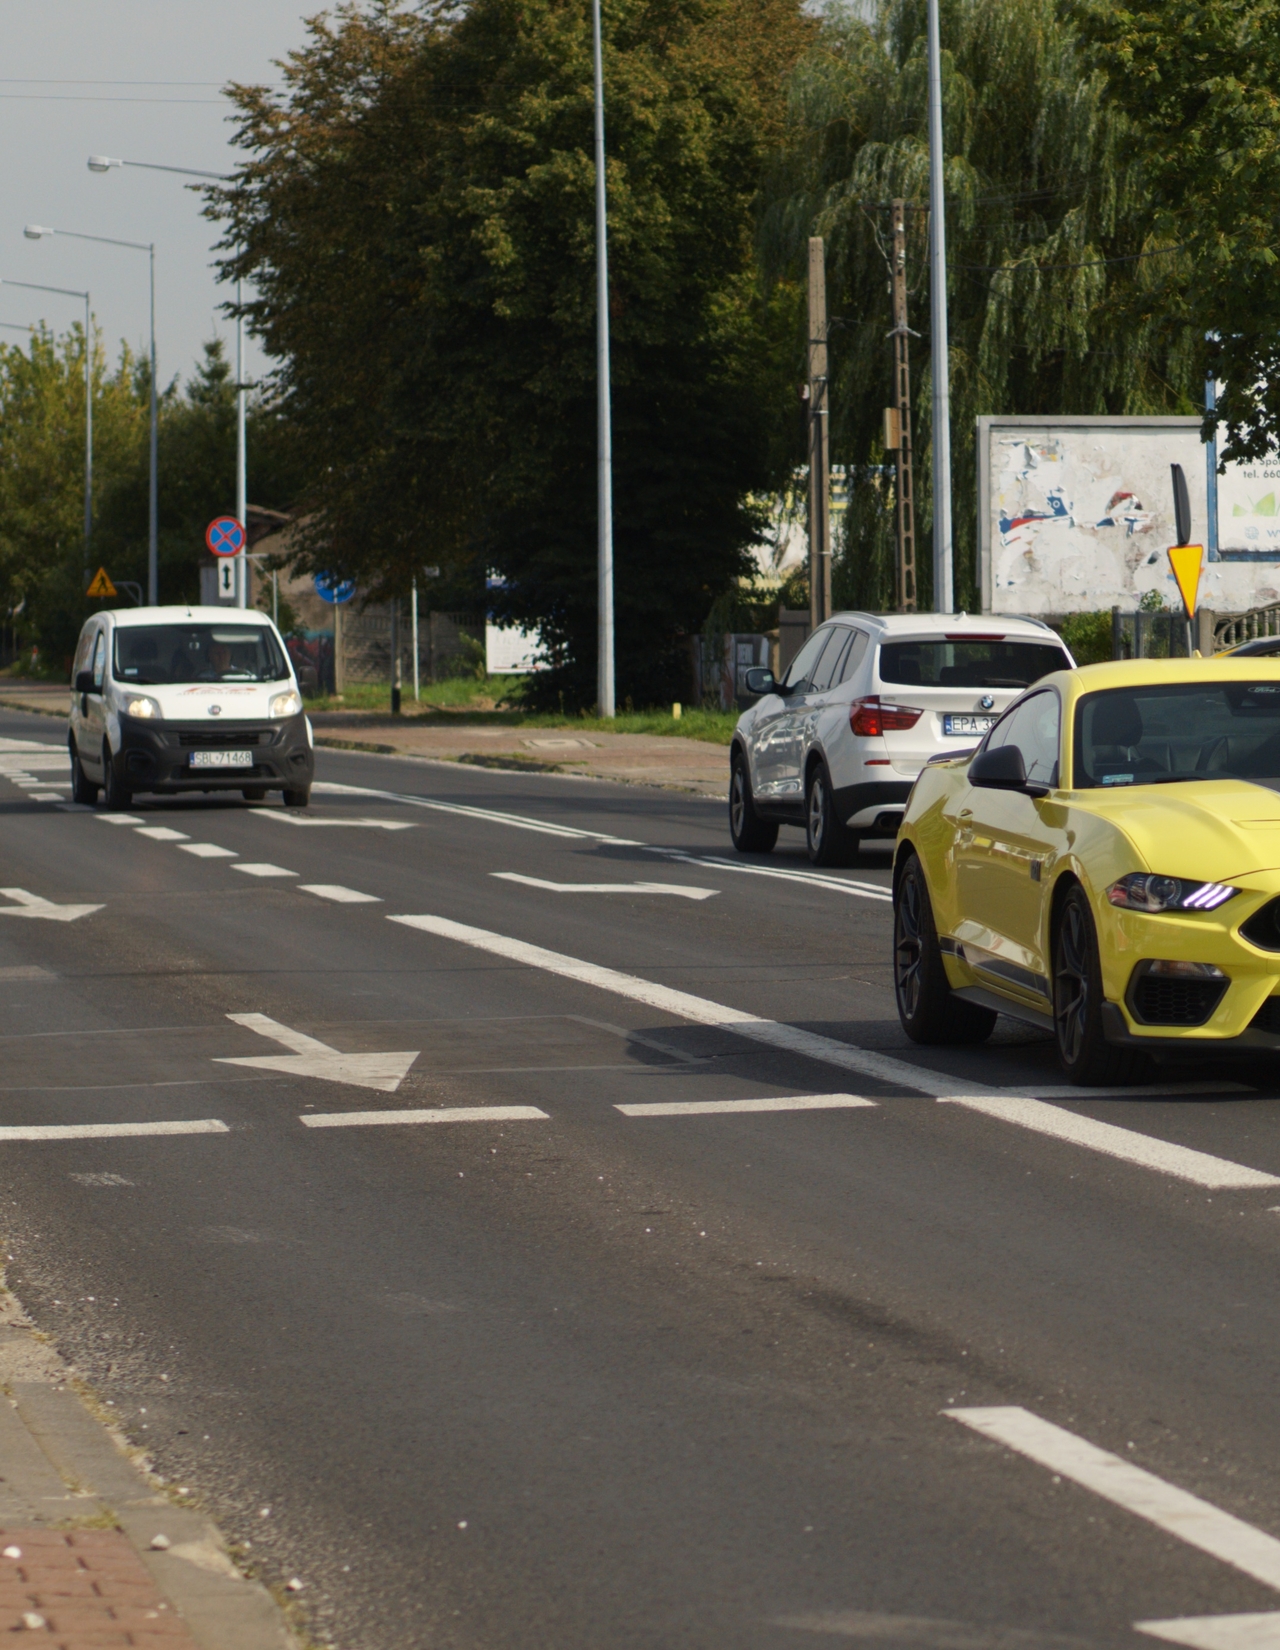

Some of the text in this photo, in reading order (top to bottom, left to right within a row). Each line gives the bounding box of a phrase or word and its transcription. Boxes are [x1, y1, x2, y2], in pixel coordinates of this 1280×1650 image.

[1243, 470, 1260, 479] tel.
[953, 717, 978, 731] EPA
[195, 752, 214, 765] SBL
[219, 751, 251, 764] 71468
